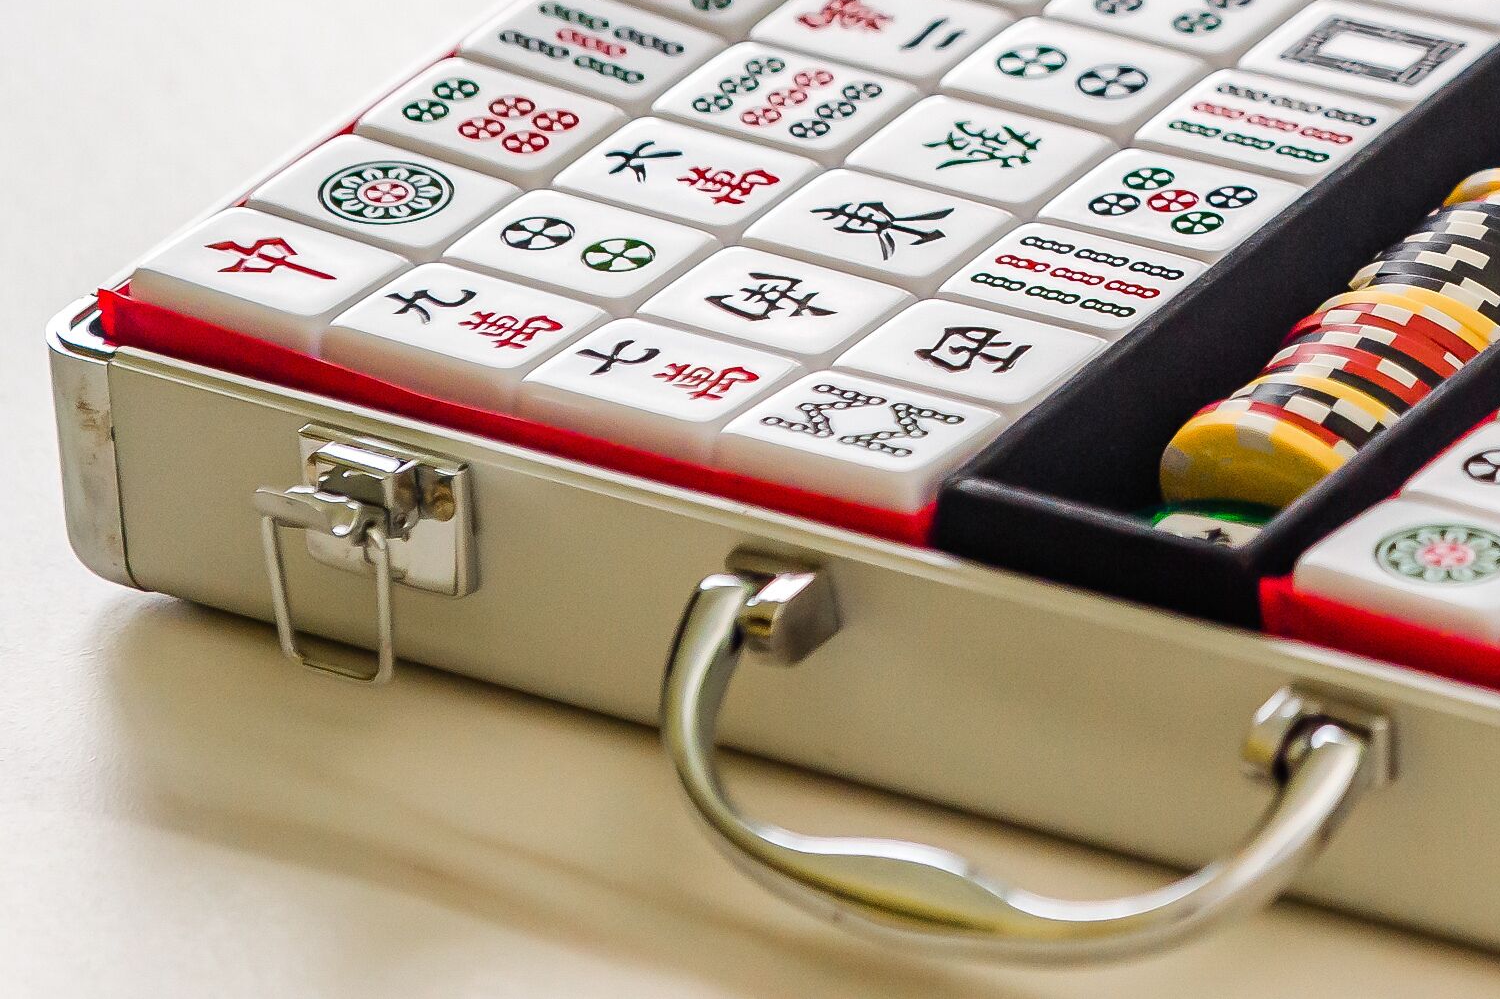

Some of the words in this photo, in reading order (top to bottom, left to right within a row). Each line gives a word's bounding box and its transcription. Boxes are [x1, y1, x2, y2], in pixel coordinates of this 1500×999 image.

[922, 120, 1042, 169] 發
[604, 141, 780, 204] 六萬
[810, 201, 955, 260] 東
[204, 236, 337, 280] 中
[385, 289, 563, 350] 九萬
[704, 272, 836, 322] 南
[576, 339, 760, 401] 七萬
[915, 326, 1032, 375] 西
